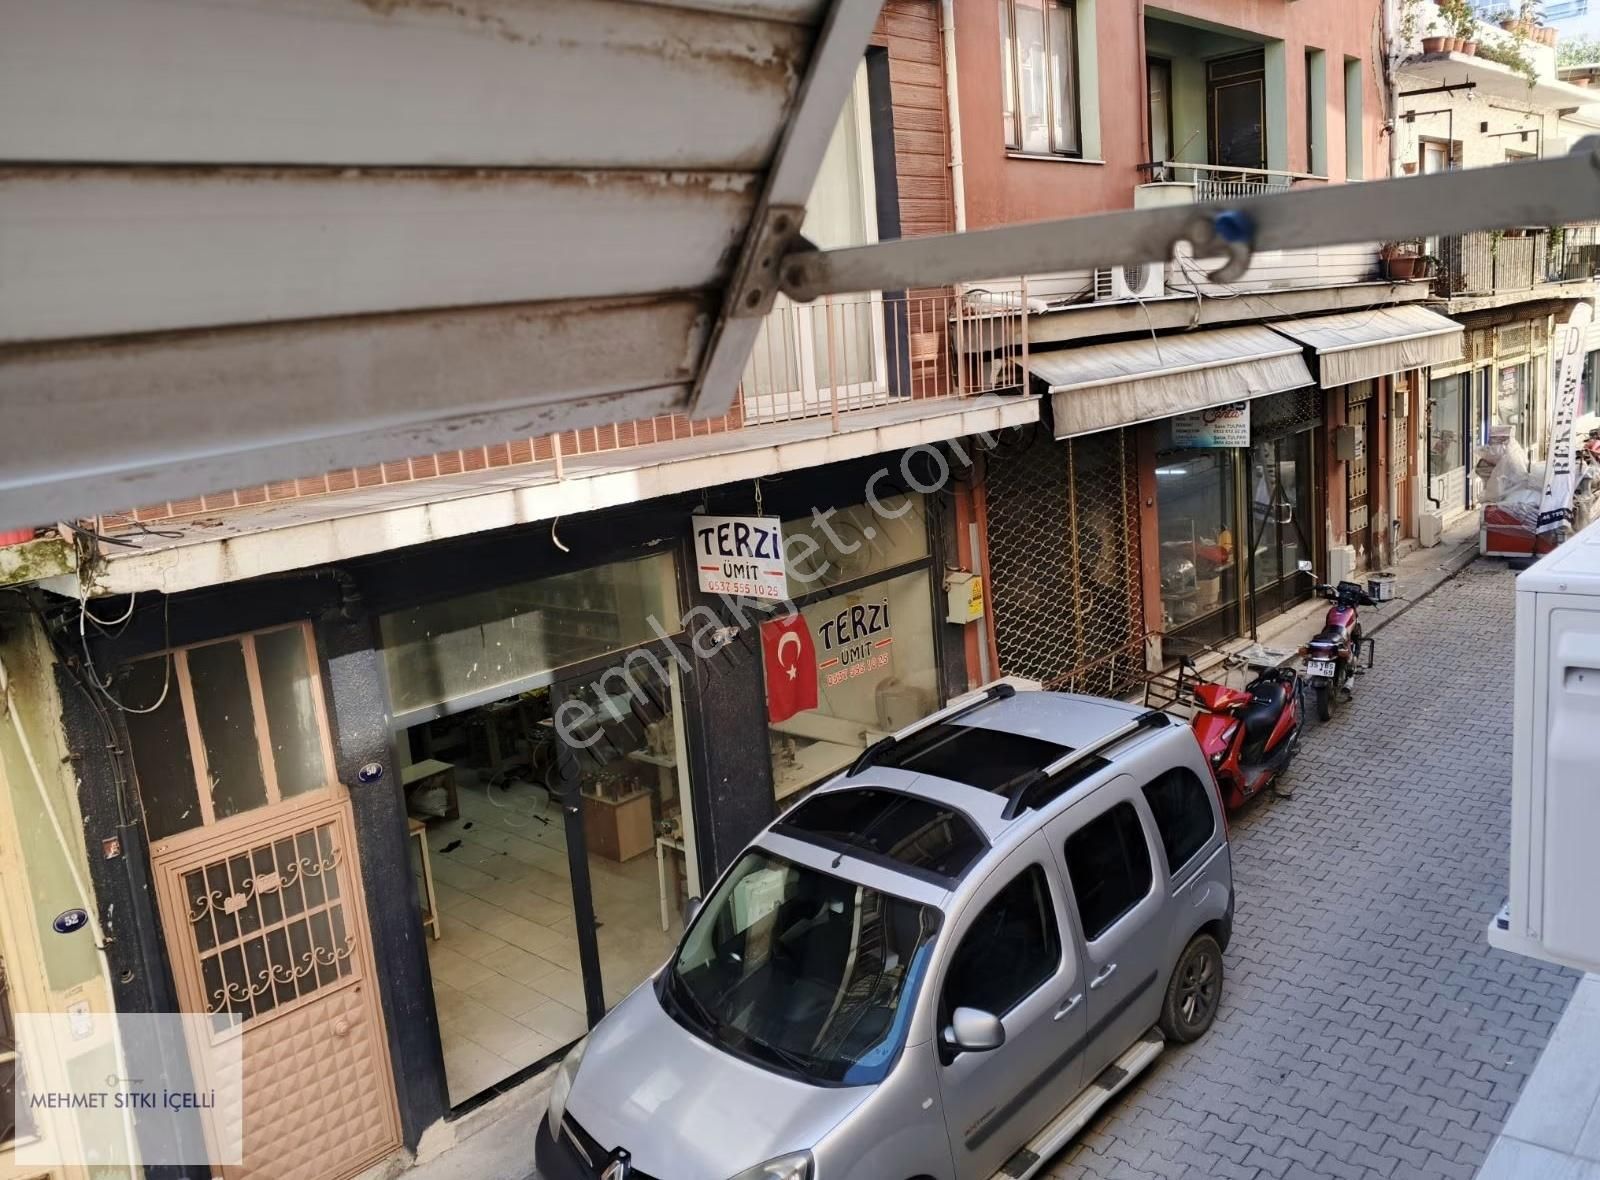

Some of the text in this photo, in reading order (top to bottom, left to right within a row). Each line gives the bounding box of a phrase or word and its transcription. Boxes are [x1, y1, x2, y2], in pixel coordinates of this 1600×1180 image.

[698, 522, 781, 560] TERZİ
[723, 559, 759, 581] ÜMİT
[754, 585, 765, 596] 10
[818, 596, 890, 650] TERZİ
[64, 913, 79, 927] 52
